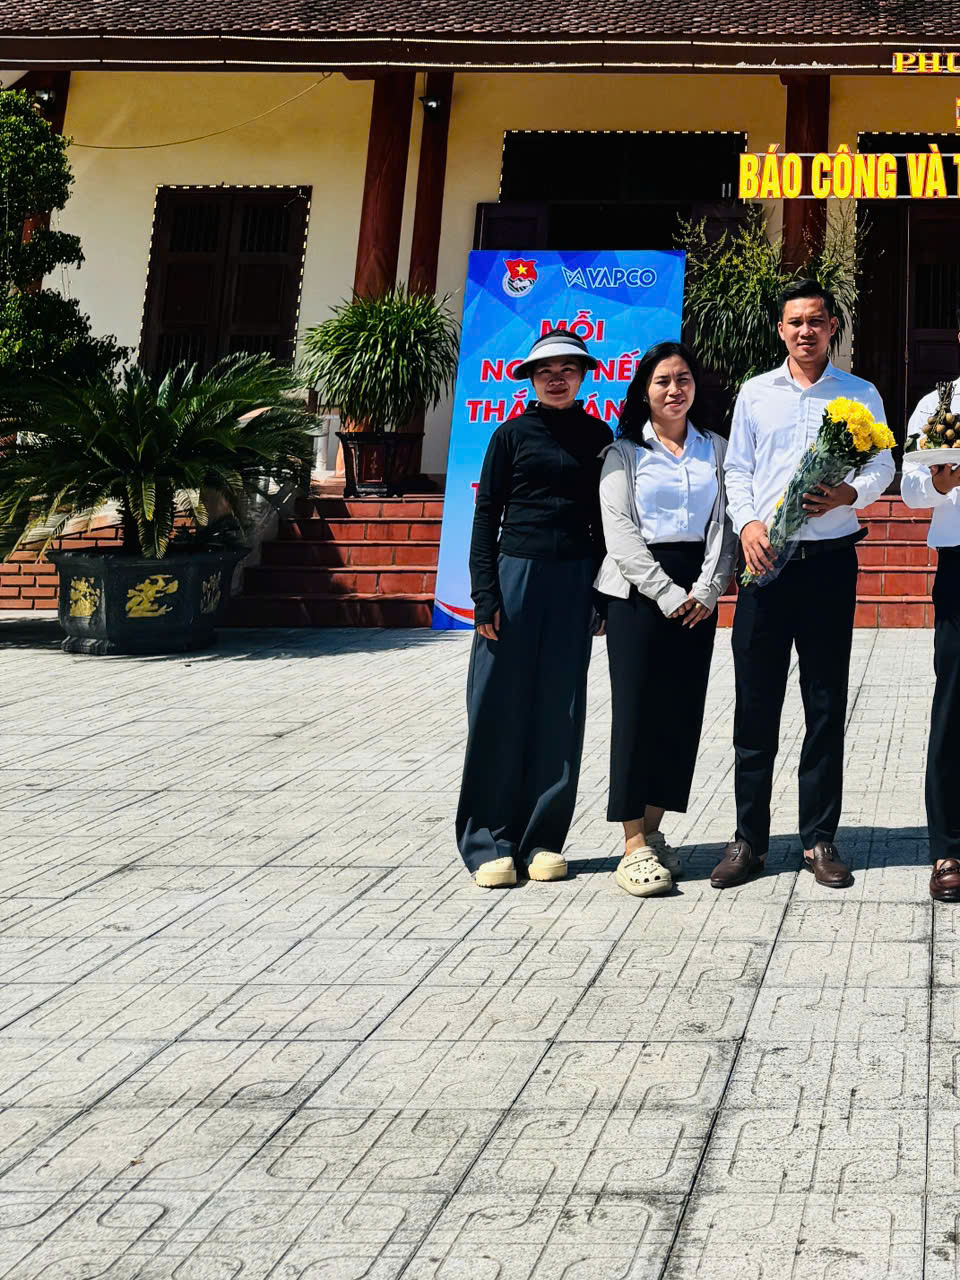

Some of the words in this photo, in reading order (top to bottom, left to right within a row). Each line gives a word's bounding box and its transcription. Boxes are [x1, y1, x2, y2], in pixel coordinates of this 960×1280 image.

[738, 143, 803, 199] BÁO
[811, 143, 898, 199] CÔNG
[906, 143, 948, 199] VÀ
[587, 266, 658, 289] VAPCO
[593, 349, 641, 381] NẾ
[467, 388, 529, 422] THẮ
